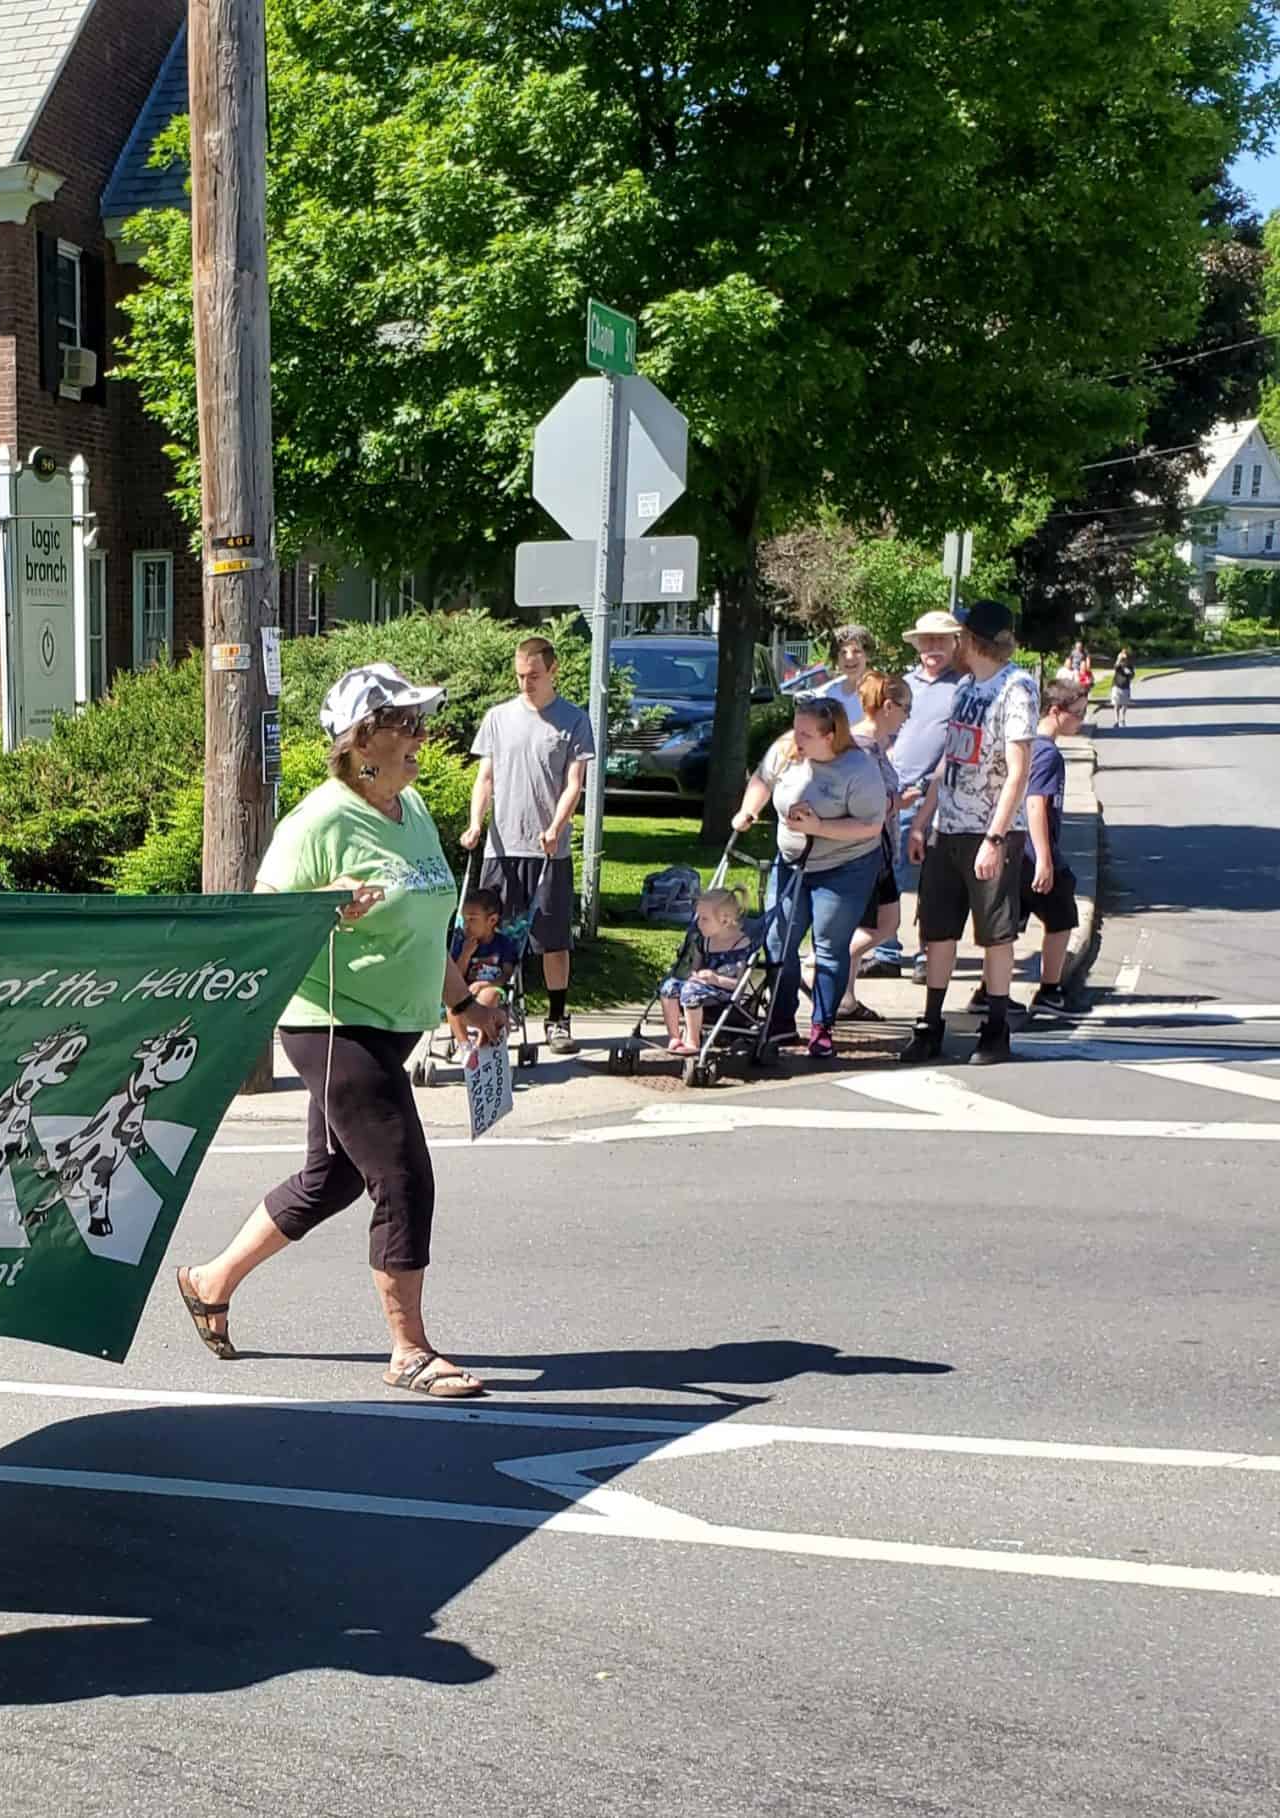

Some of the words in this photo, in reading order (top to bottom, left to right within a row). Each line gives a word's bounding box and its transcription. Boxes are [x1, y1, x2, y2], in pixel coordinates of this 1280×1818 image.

[32, 520, 60, 556] logic
[26, 553, 67, 582] branch
[42, 970, 118, 1009] the
[121, 957, 269, 1003] Heifers
